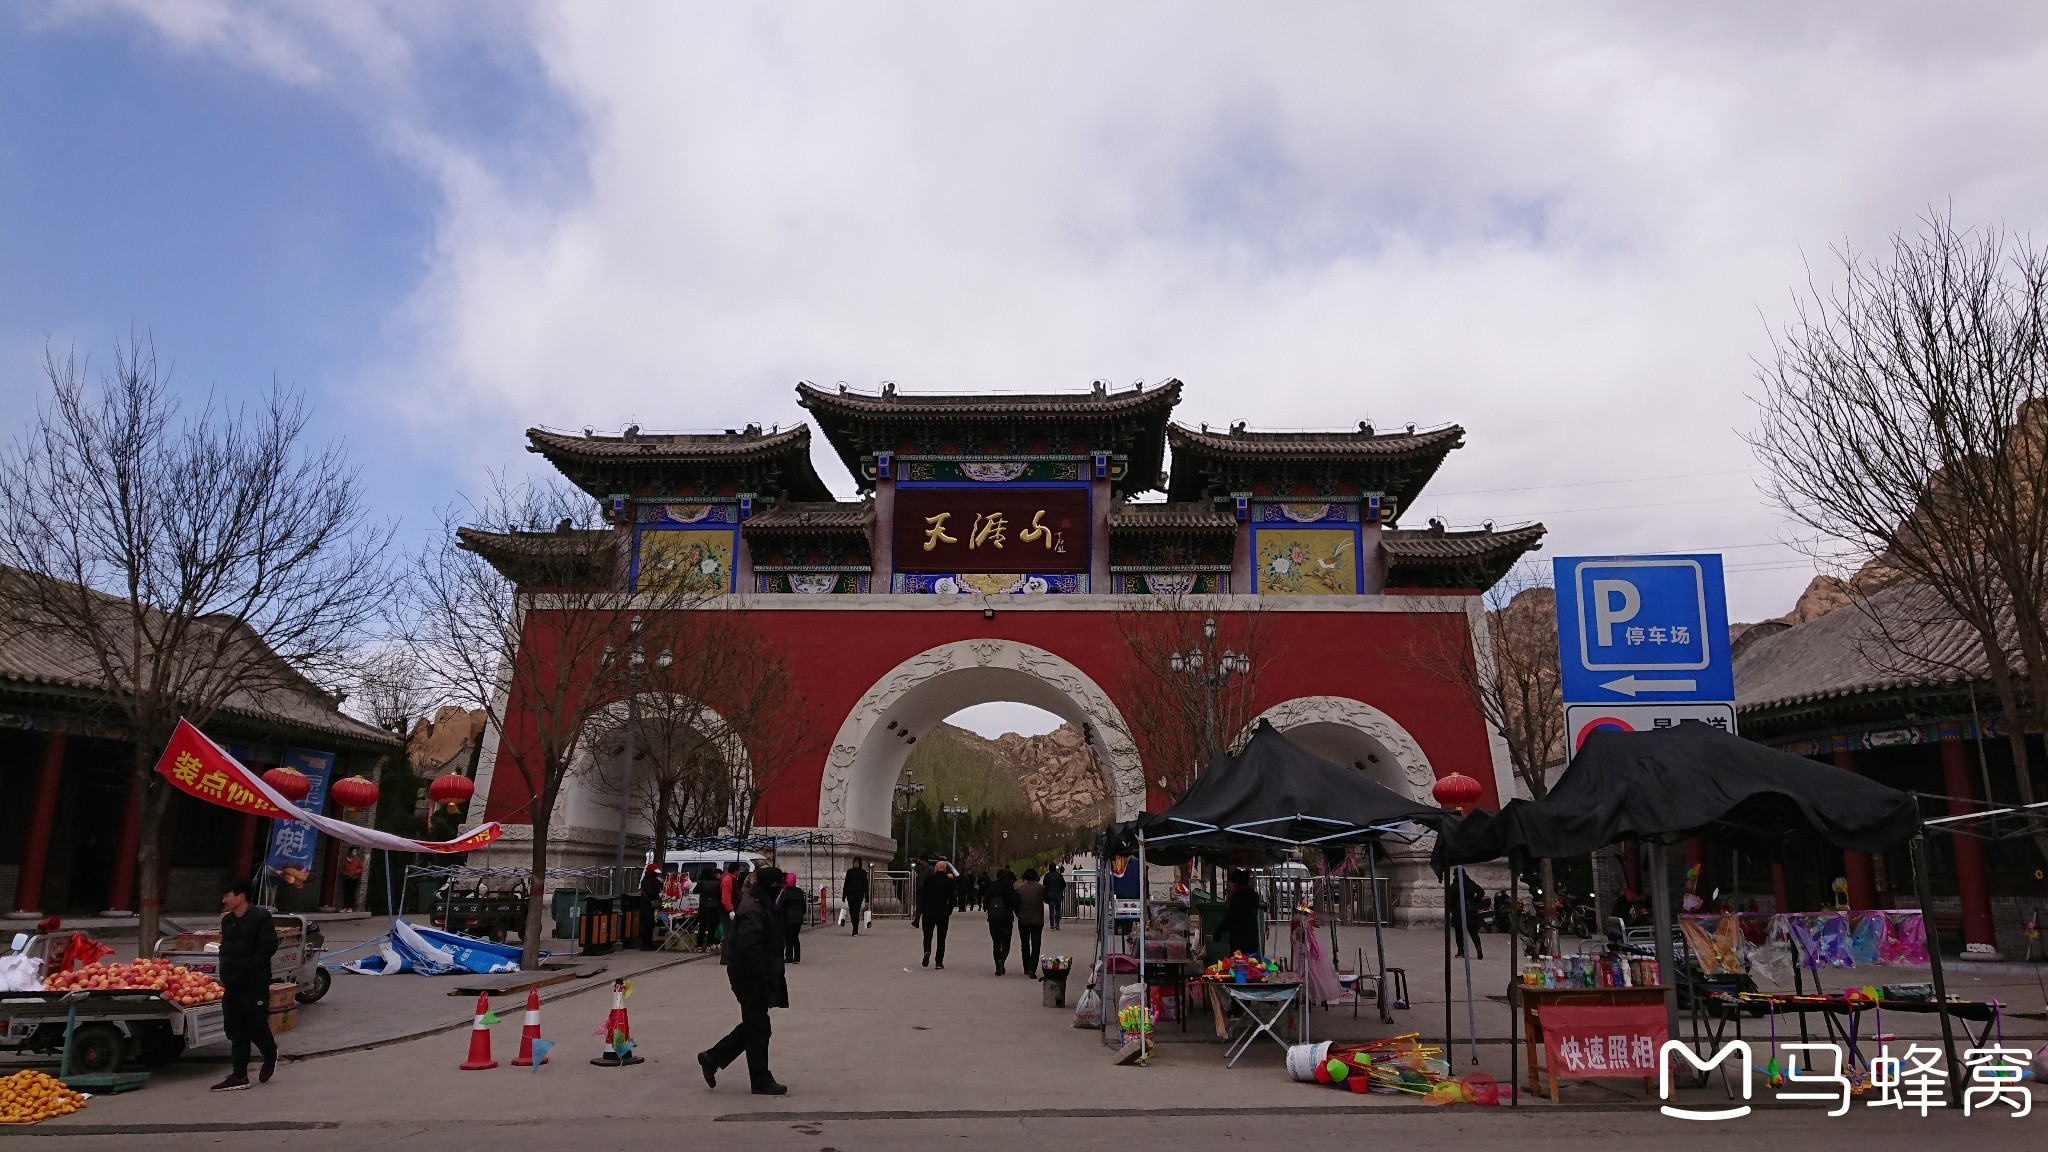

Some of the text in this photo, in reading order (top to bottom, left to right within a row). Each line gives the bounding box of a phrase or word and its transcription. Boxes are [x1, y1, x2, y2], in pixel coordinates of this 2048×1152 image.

[923, 509, 1052, 551] 天涯山
[1593, 580, 1641, 647] P
[1625, 626, 1690, 646] 停车场
[1560, 1034, 1655, 1071] 快速照相
